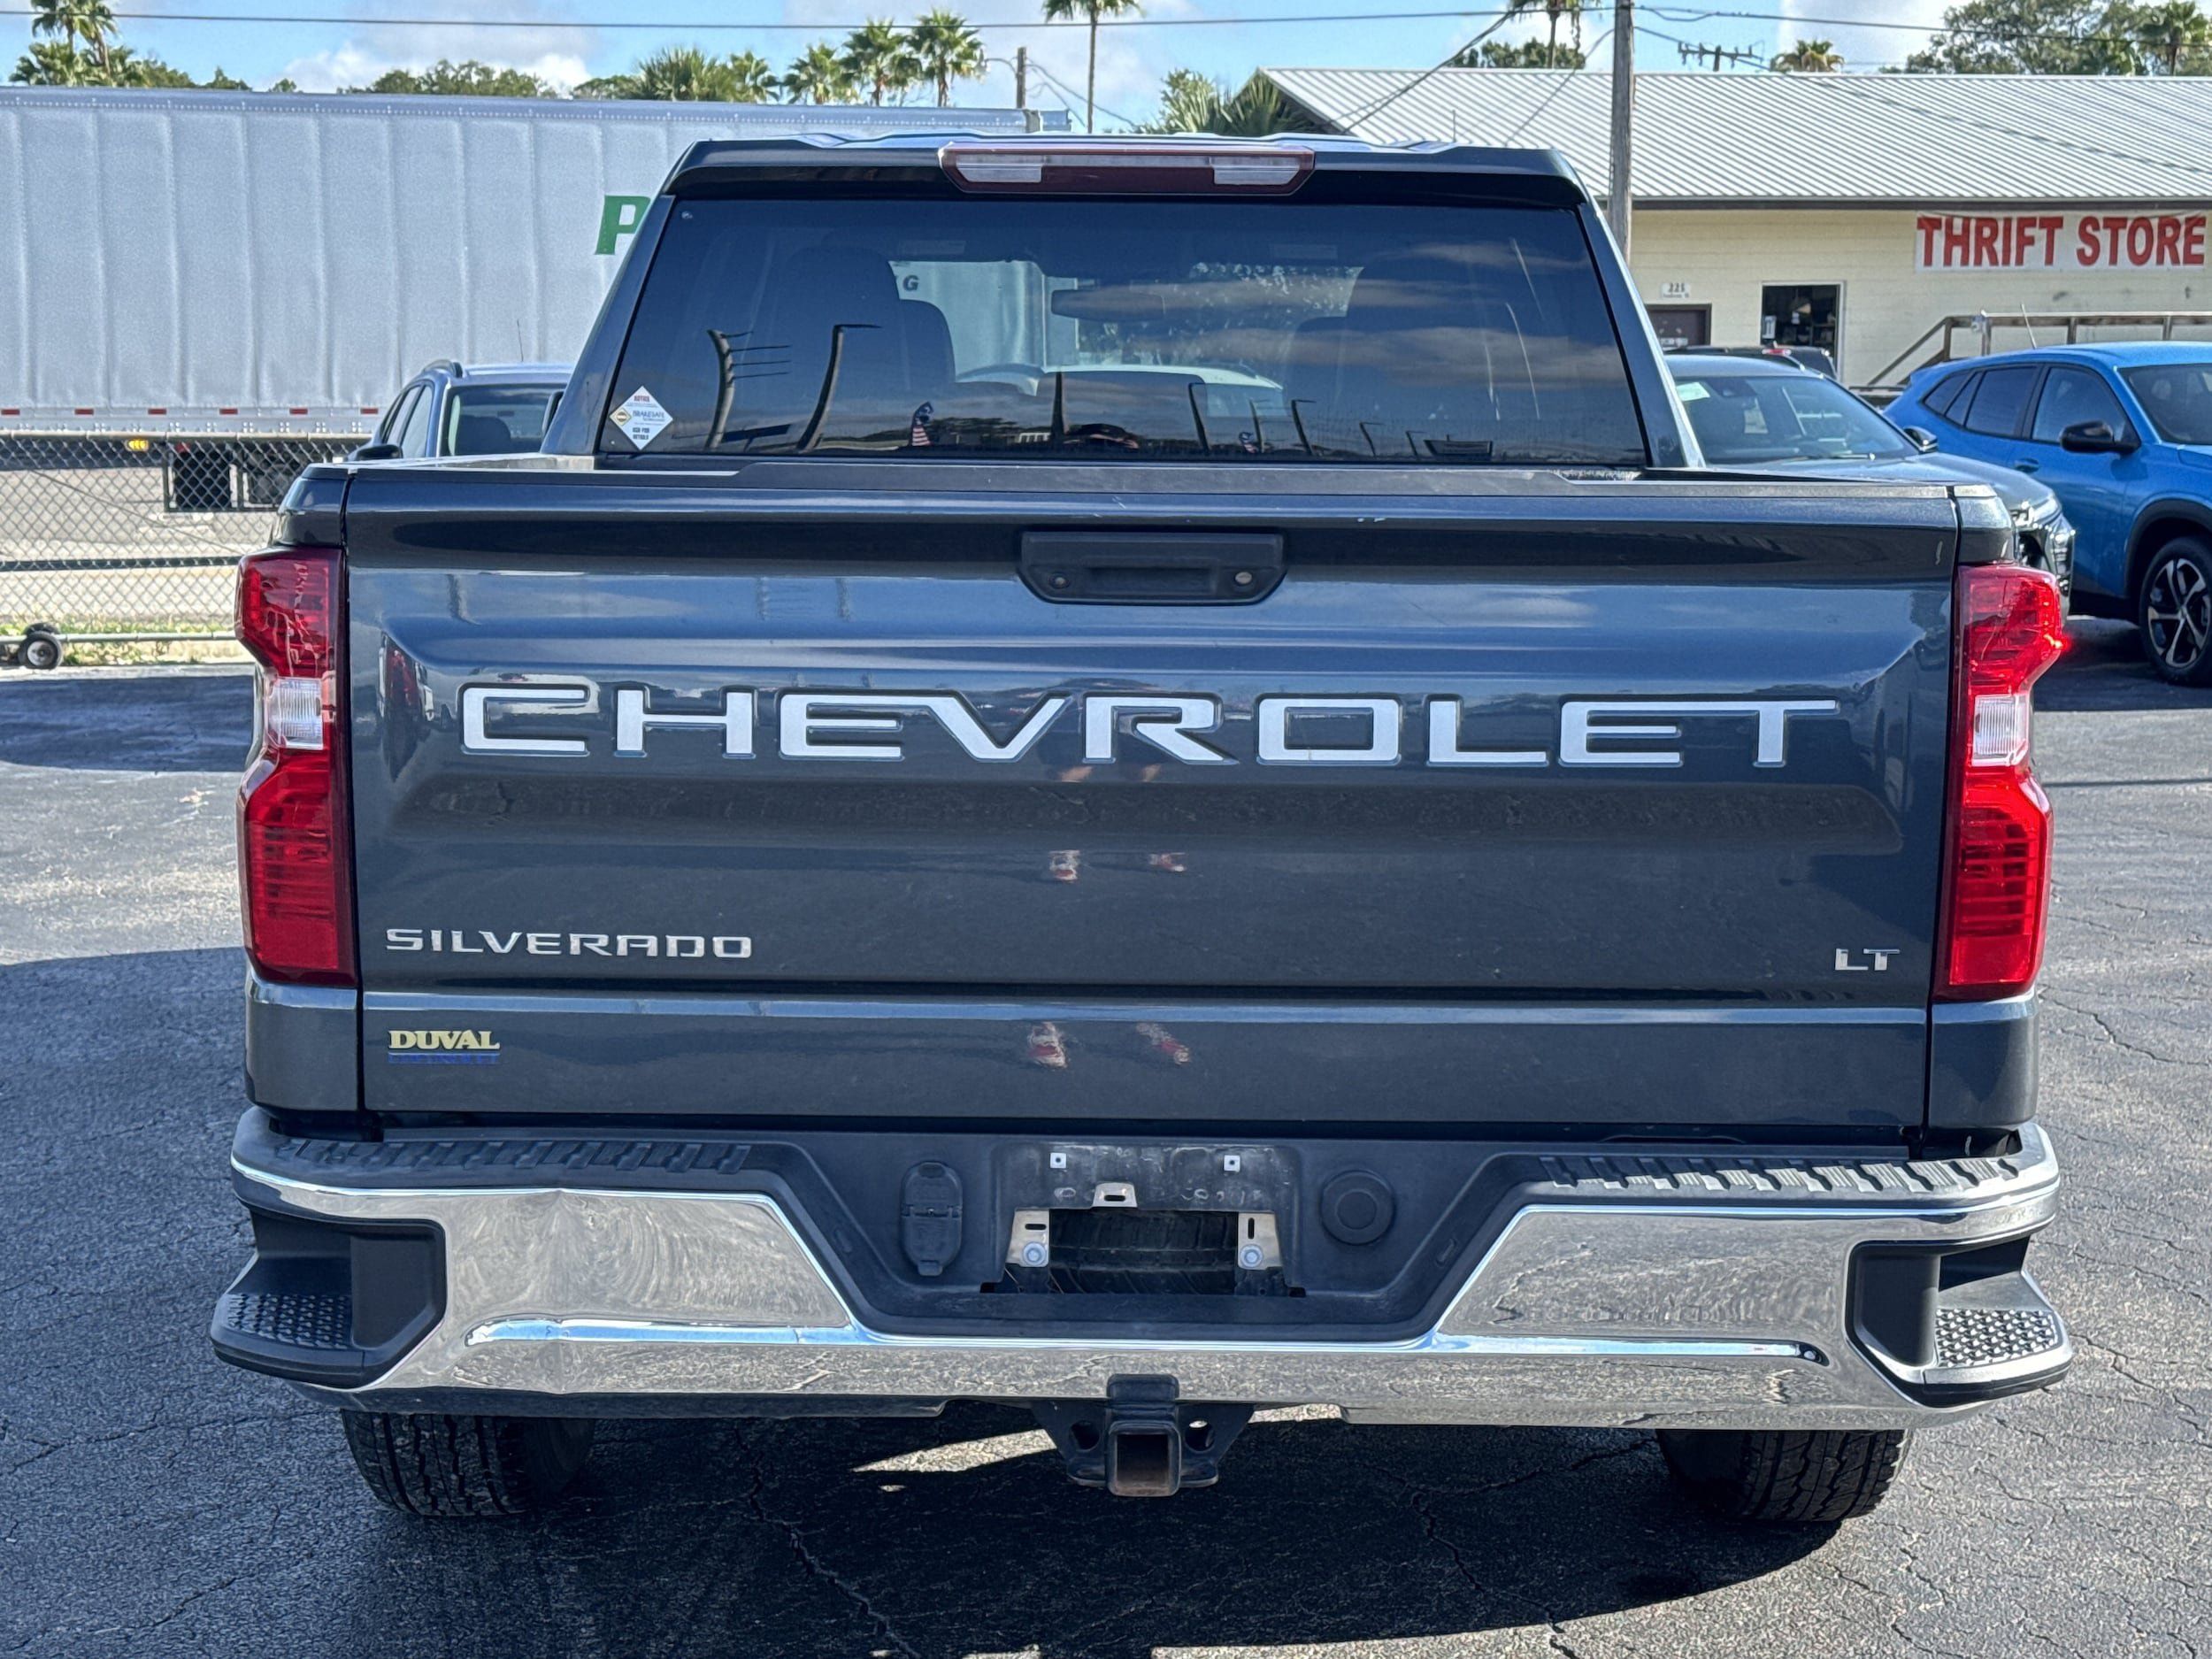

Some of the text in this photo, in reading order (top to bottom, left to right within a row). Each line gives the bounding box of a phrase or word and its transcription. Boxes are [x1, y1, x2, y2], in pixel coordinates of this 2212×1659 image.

[1916, 216, 2207, 267] THRIFT STORE
[461, 686, 1838, 766] CHEVROLET
[386, 927, 753, 958] SILVERADO
[1834, 948, 1901, 972] LT
[388, 1029, 501, 1050] DUVAL
